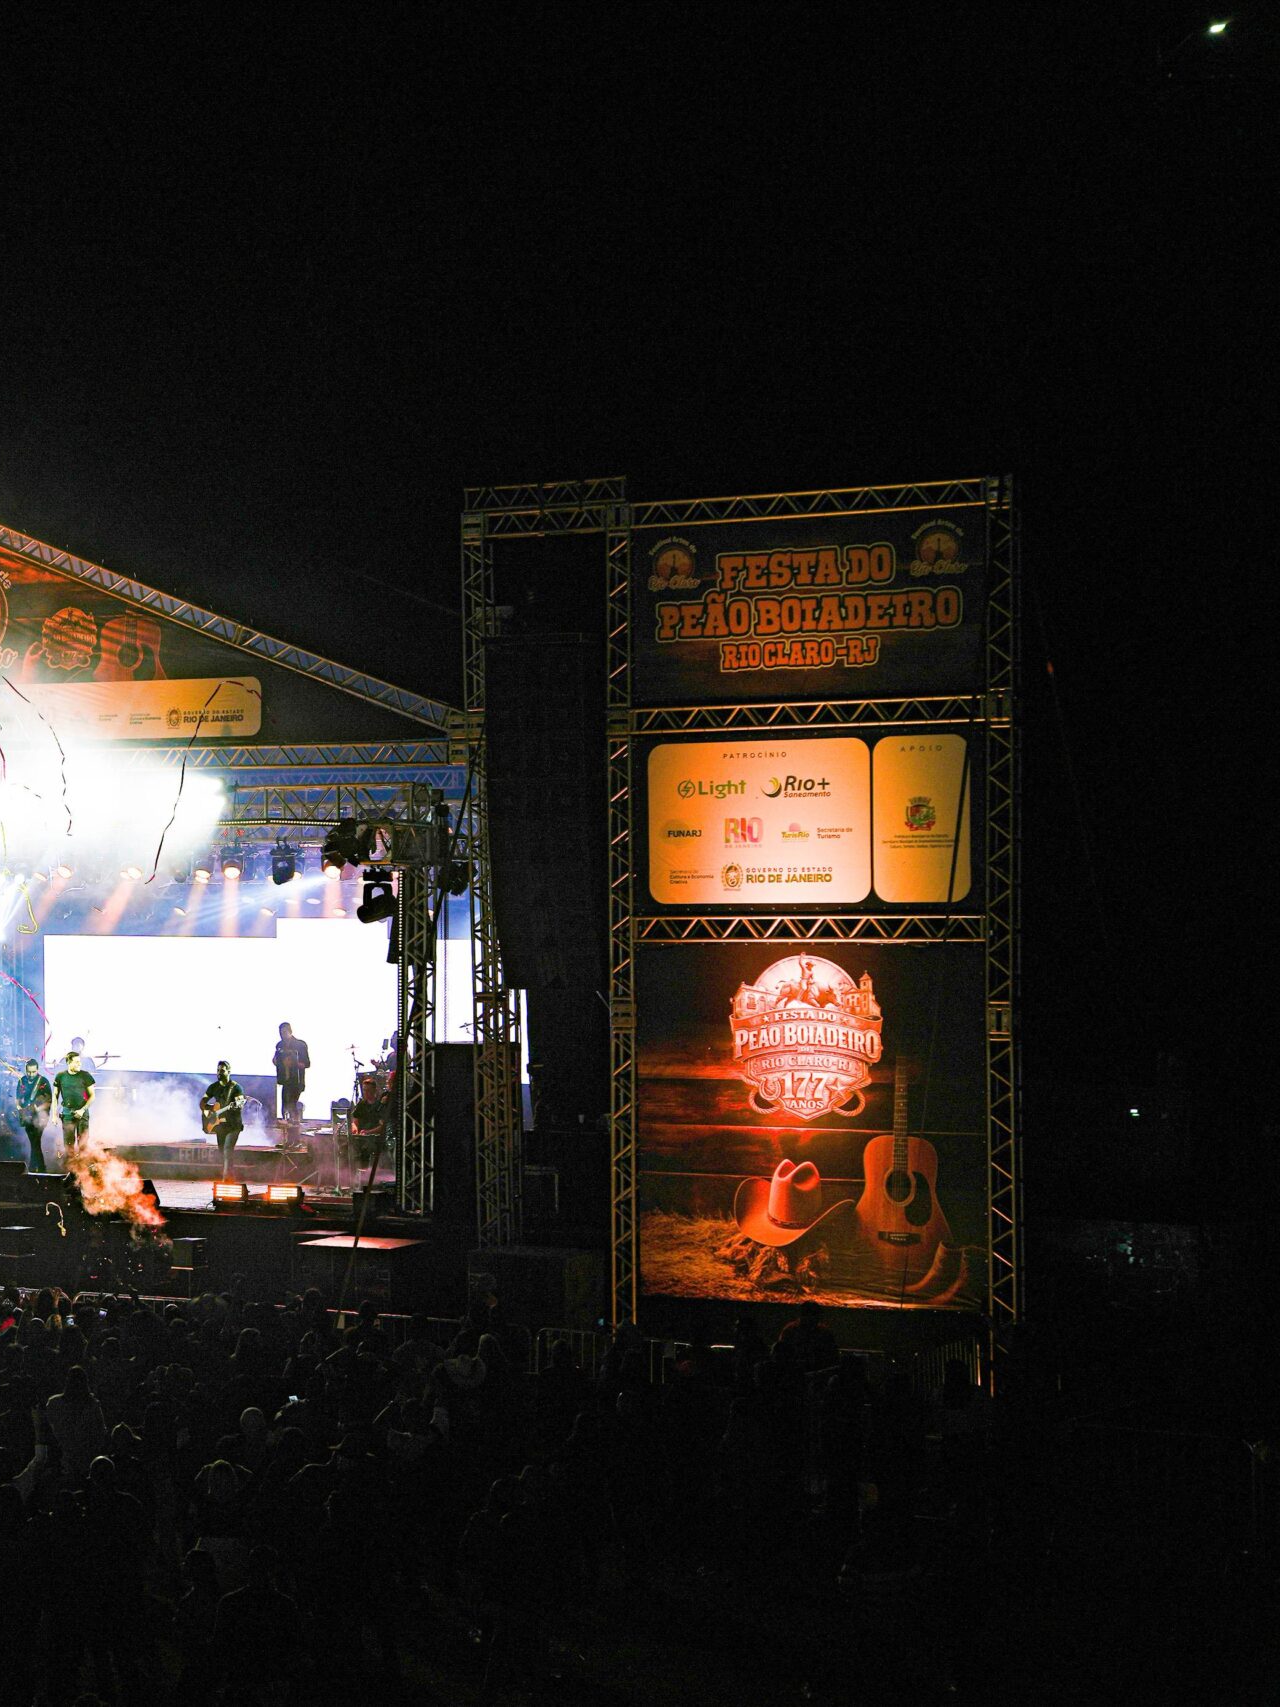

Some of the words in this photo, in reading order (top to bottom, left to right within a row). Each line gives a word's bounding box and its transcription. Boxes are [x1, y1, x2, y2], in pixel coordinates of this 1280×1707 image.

[719, 548, 841, 590] FESTA
[846, 545, 891, 585] DO
[658, 591, 752, 639] PEÃO
[755, 588, 959, 635] BOIADEIRO
[721, 643, 761, 669] RIO
[183, 715, 198, 723] RIO
[210, 714, 244, 723] JANEIRO
[723, 751, 787, 759] PATROCÍNIO
[698, 779, 747, 799] Light
[784, 791, 831, 799] Saneamento
[667, 829, 702, 838] FUNARJ
[724, 817, 763, 843] RIO
[746, 874, 765, 884] RIO
[767, 874, 782, 883] DE
[785, 873, 833, 883] JANEIRO
[774, 1010, 815, 1021] FESTA
[818, 1011, 837, 1021] DO
[735, 1025, 781, 1059] PEÃO
[784, 1023, 880, 1059] BOIADEIRO
[761, 1056, 784, 1070] RIO
[782, 1071, 829, 1099] 177
[790, 1100, 825, 1109] ANOS
